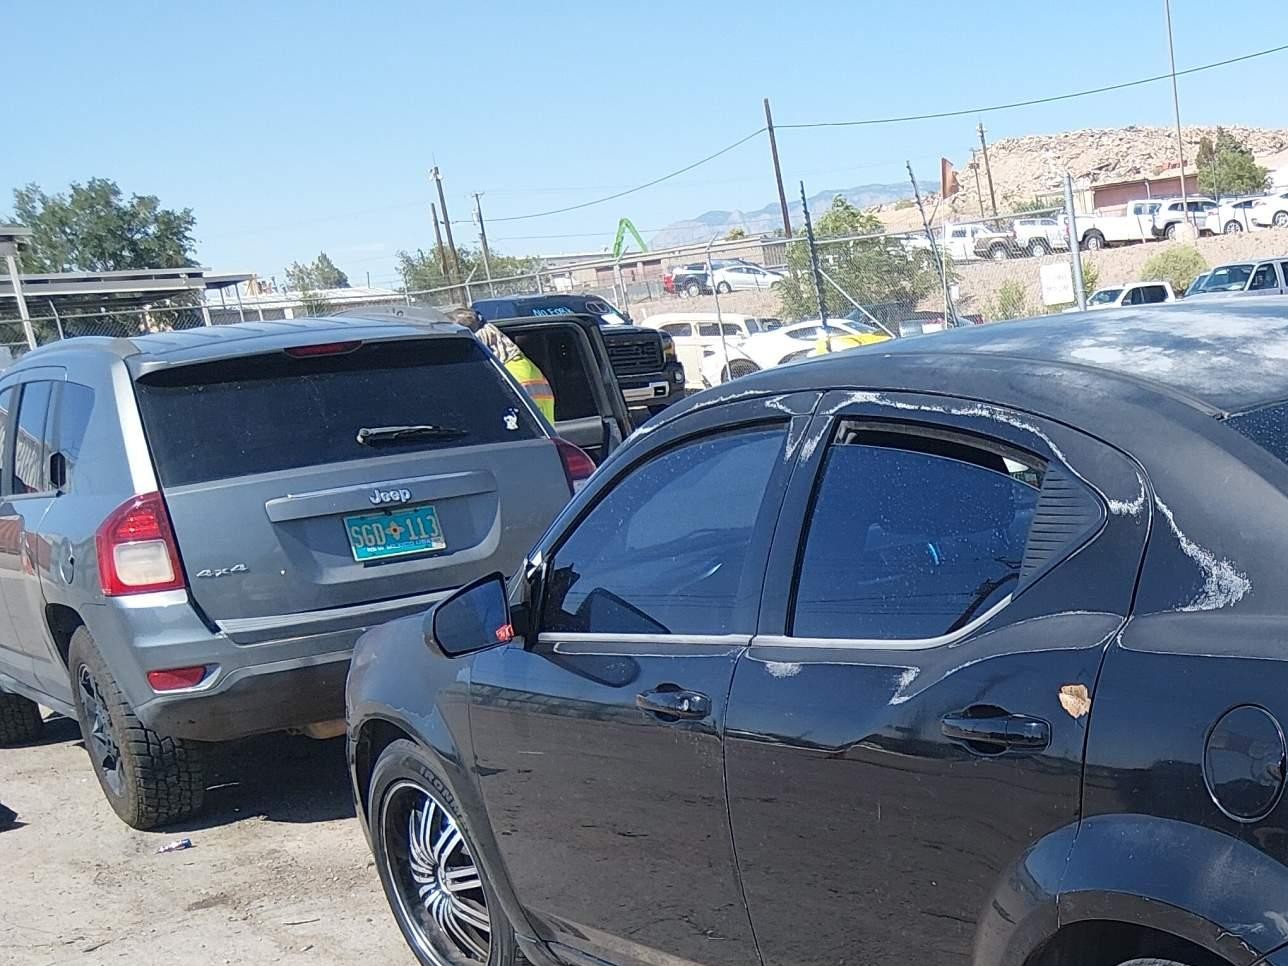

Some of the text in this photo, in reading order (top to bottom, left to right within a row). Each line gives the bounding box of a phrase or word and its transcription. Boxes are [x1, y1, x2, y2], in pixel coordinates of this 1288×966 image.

[369, 489, 411, 504] Jeep
[351, 516, 439, 548] SGD 113
[196, 563, 248, 577] 4x4
